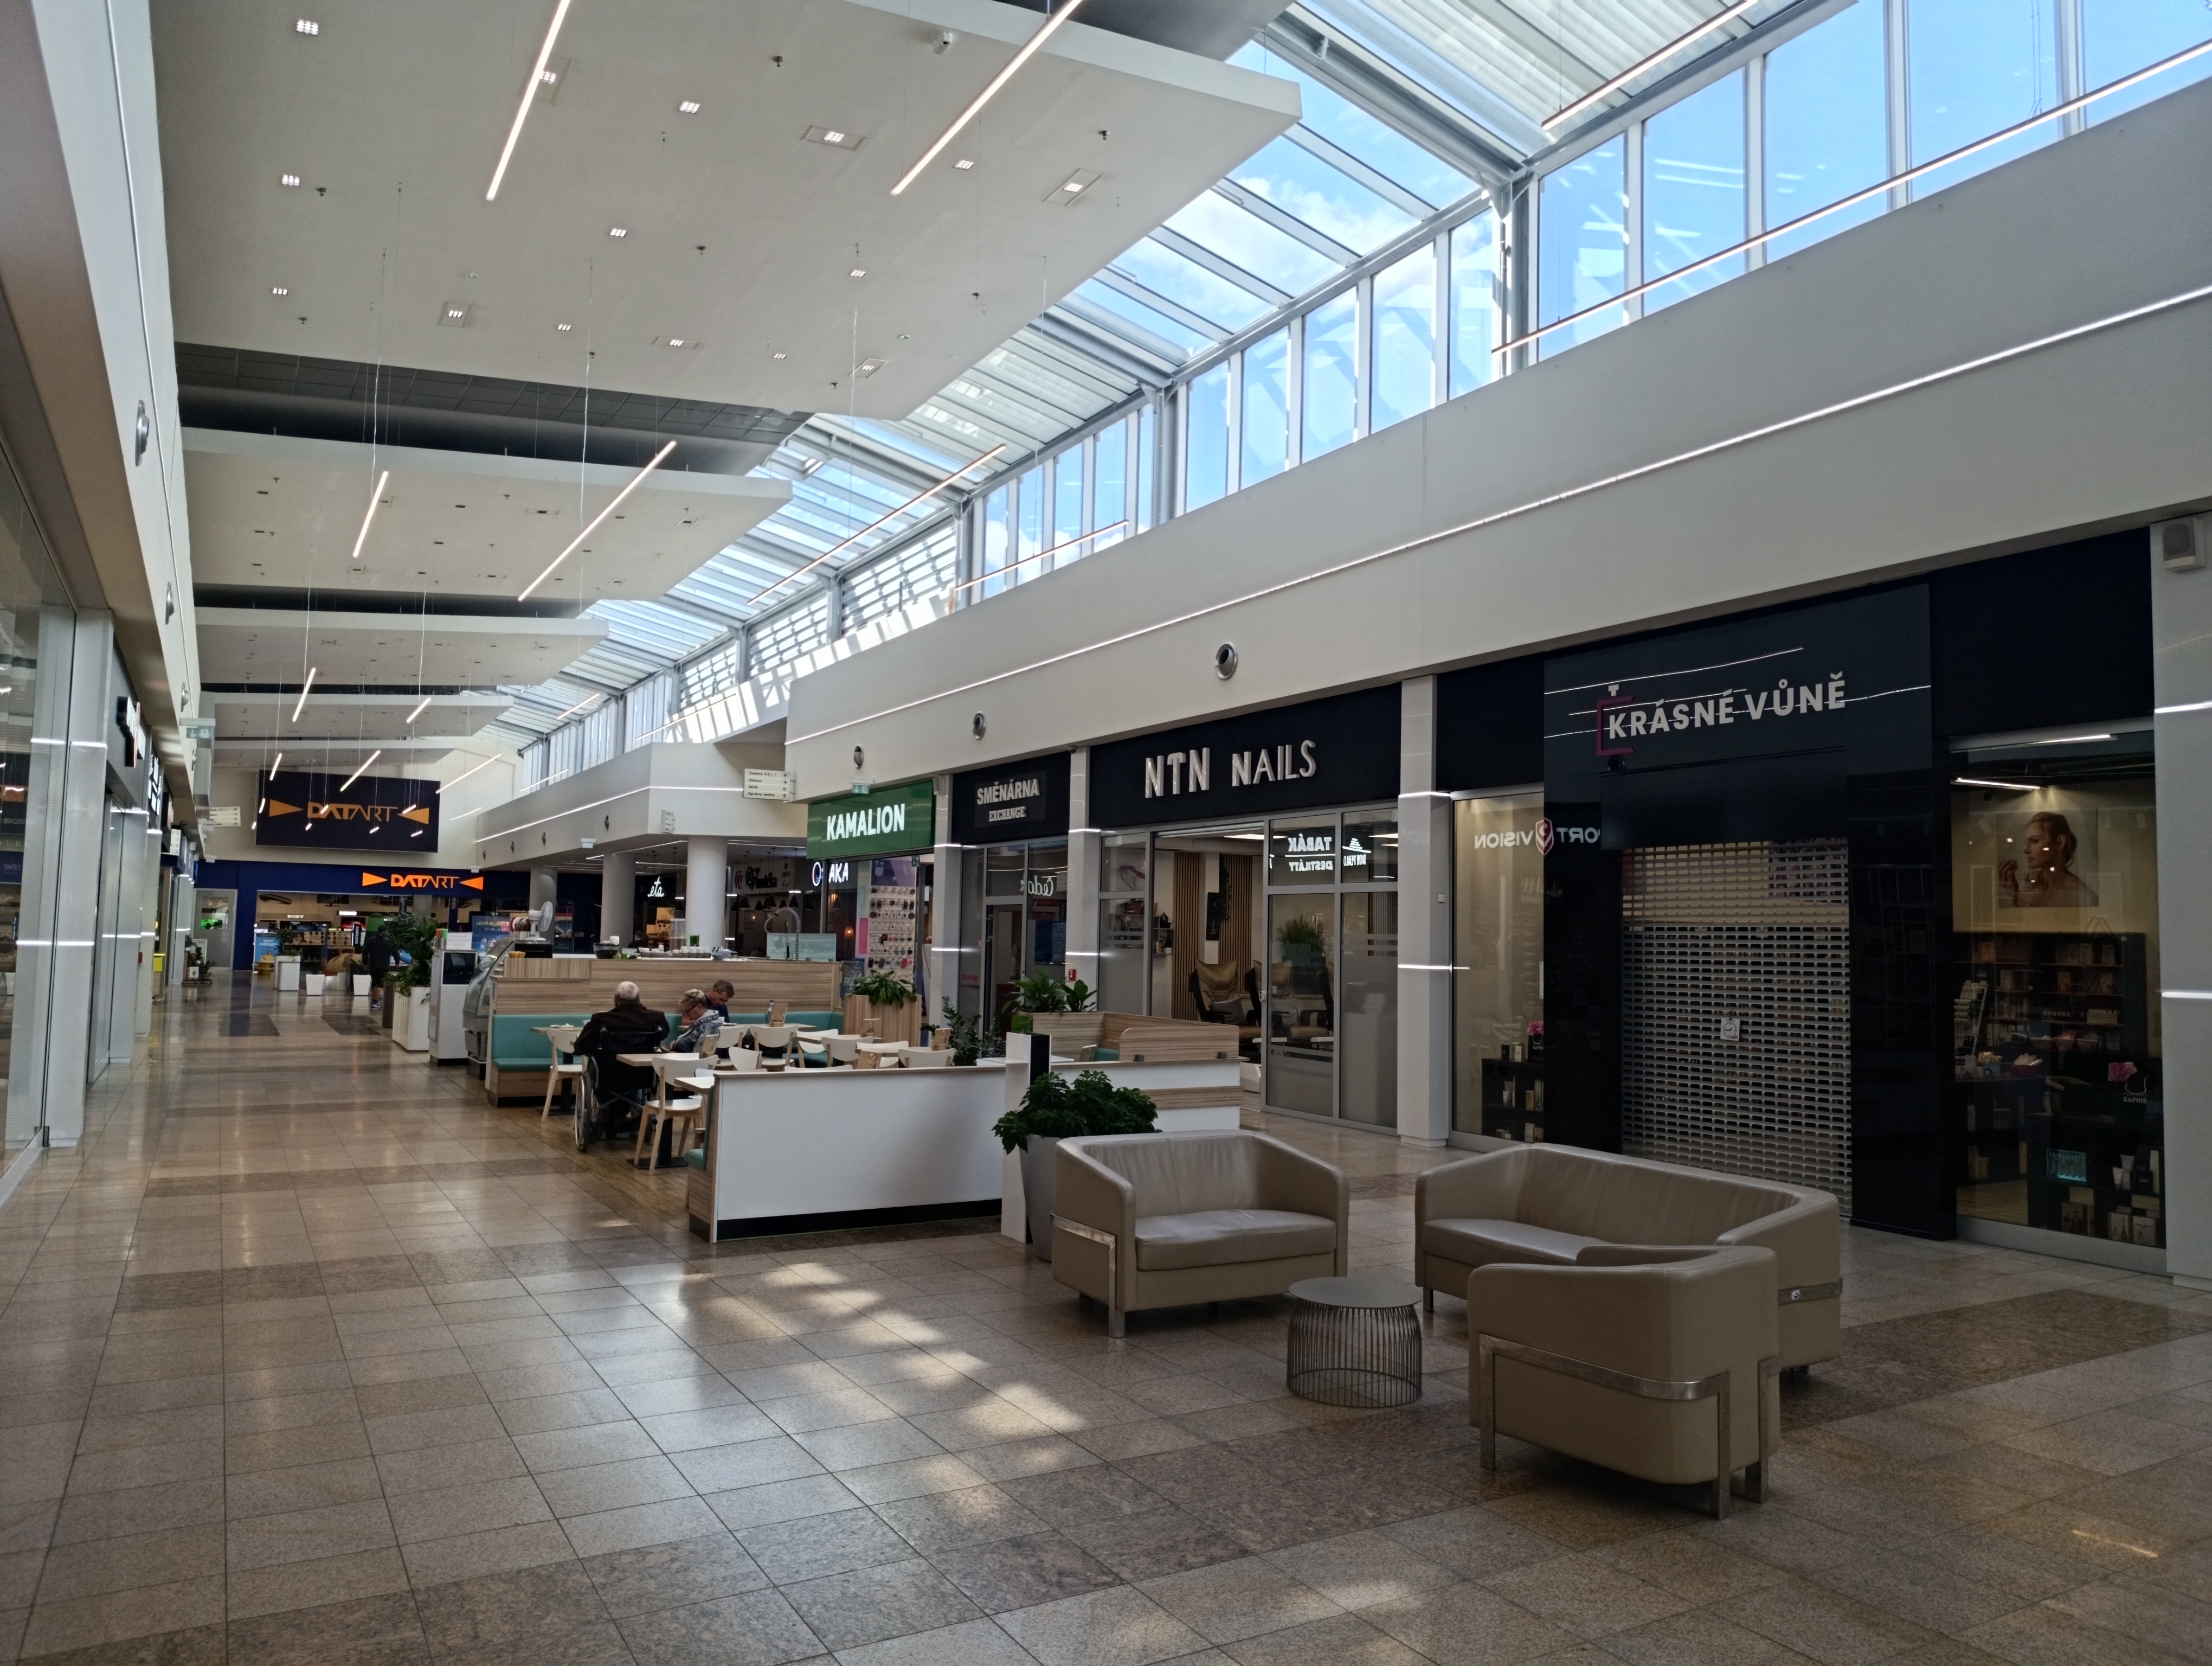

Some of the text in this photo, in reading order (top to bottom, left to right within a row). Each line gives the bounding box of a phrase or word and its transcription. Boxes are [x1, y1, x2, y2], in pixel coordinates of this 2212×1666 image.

[1609, 671, 1846, 740] KRÁSNÉ VŮNĚ
[1145, 739, 1317, 799] NTN NAILS
[977, 778, 1040, 805] SMĚNÁRNA
[307, 802, 398, 822] DATART
[826, 803, 905, 841] KAMALION
[988, 806, 1027, 822] EXCHANGE
[390, 874, 460, 889] DATART
[647, 876, 665, 898] eta
[812, 862, 848, 887] OAKA
